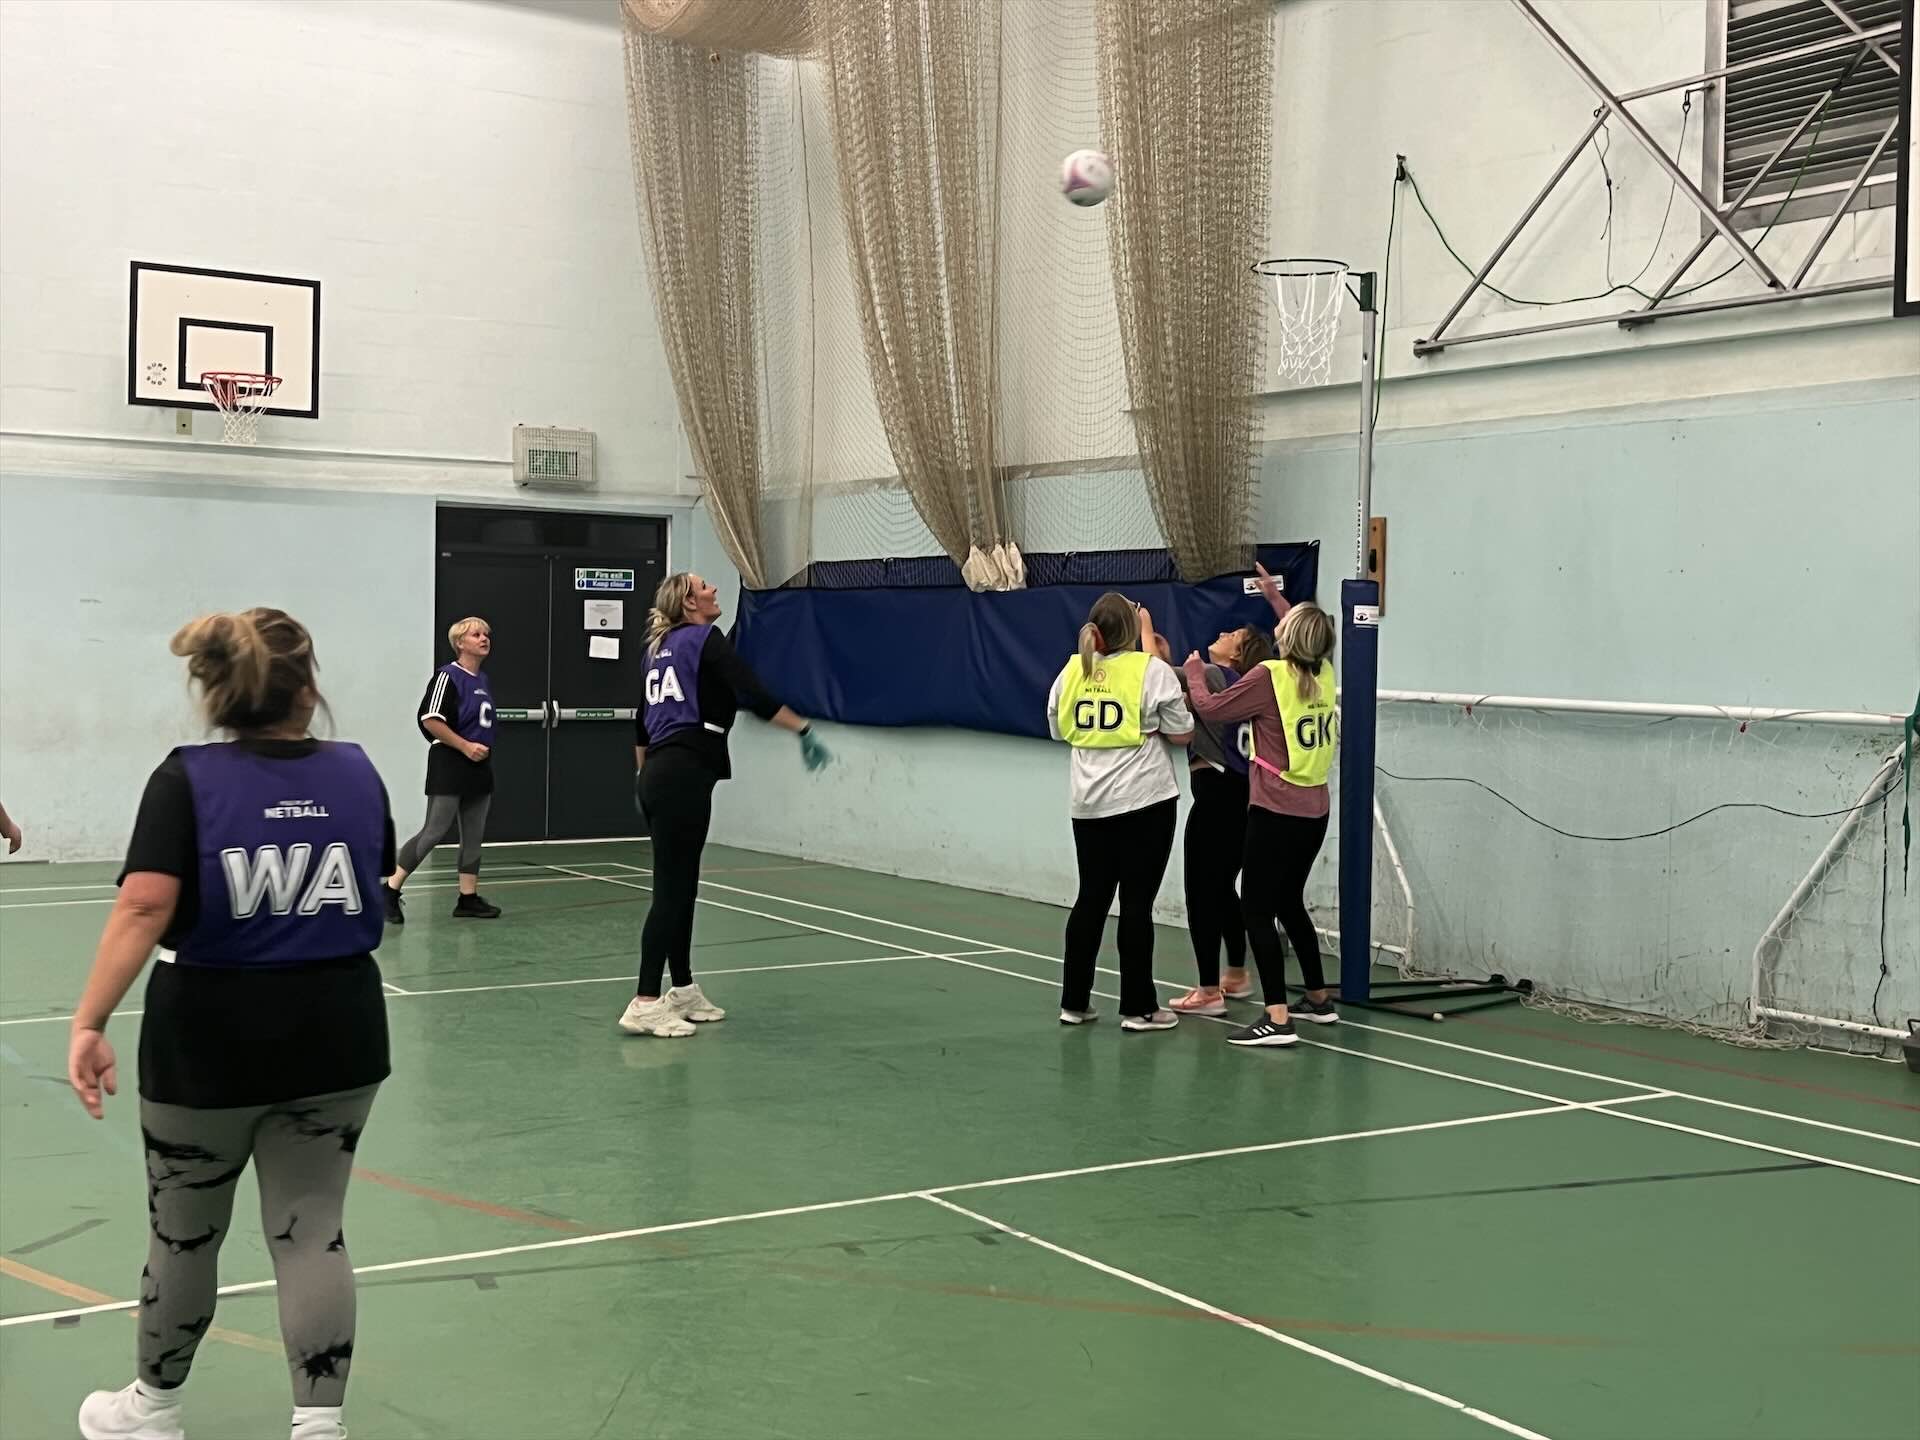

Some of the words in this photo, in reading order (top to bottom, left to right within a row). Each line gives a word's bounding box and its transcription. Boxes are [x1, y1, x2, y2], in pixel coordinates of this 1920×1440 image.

[645, 666, 685, 705] GA
[1074, 699, 1124, 731] GD
[1295, 711, 1334, 750] GK
[264, 806, 329, 819] NETBALL
[220, 842, 363, 919] WA
